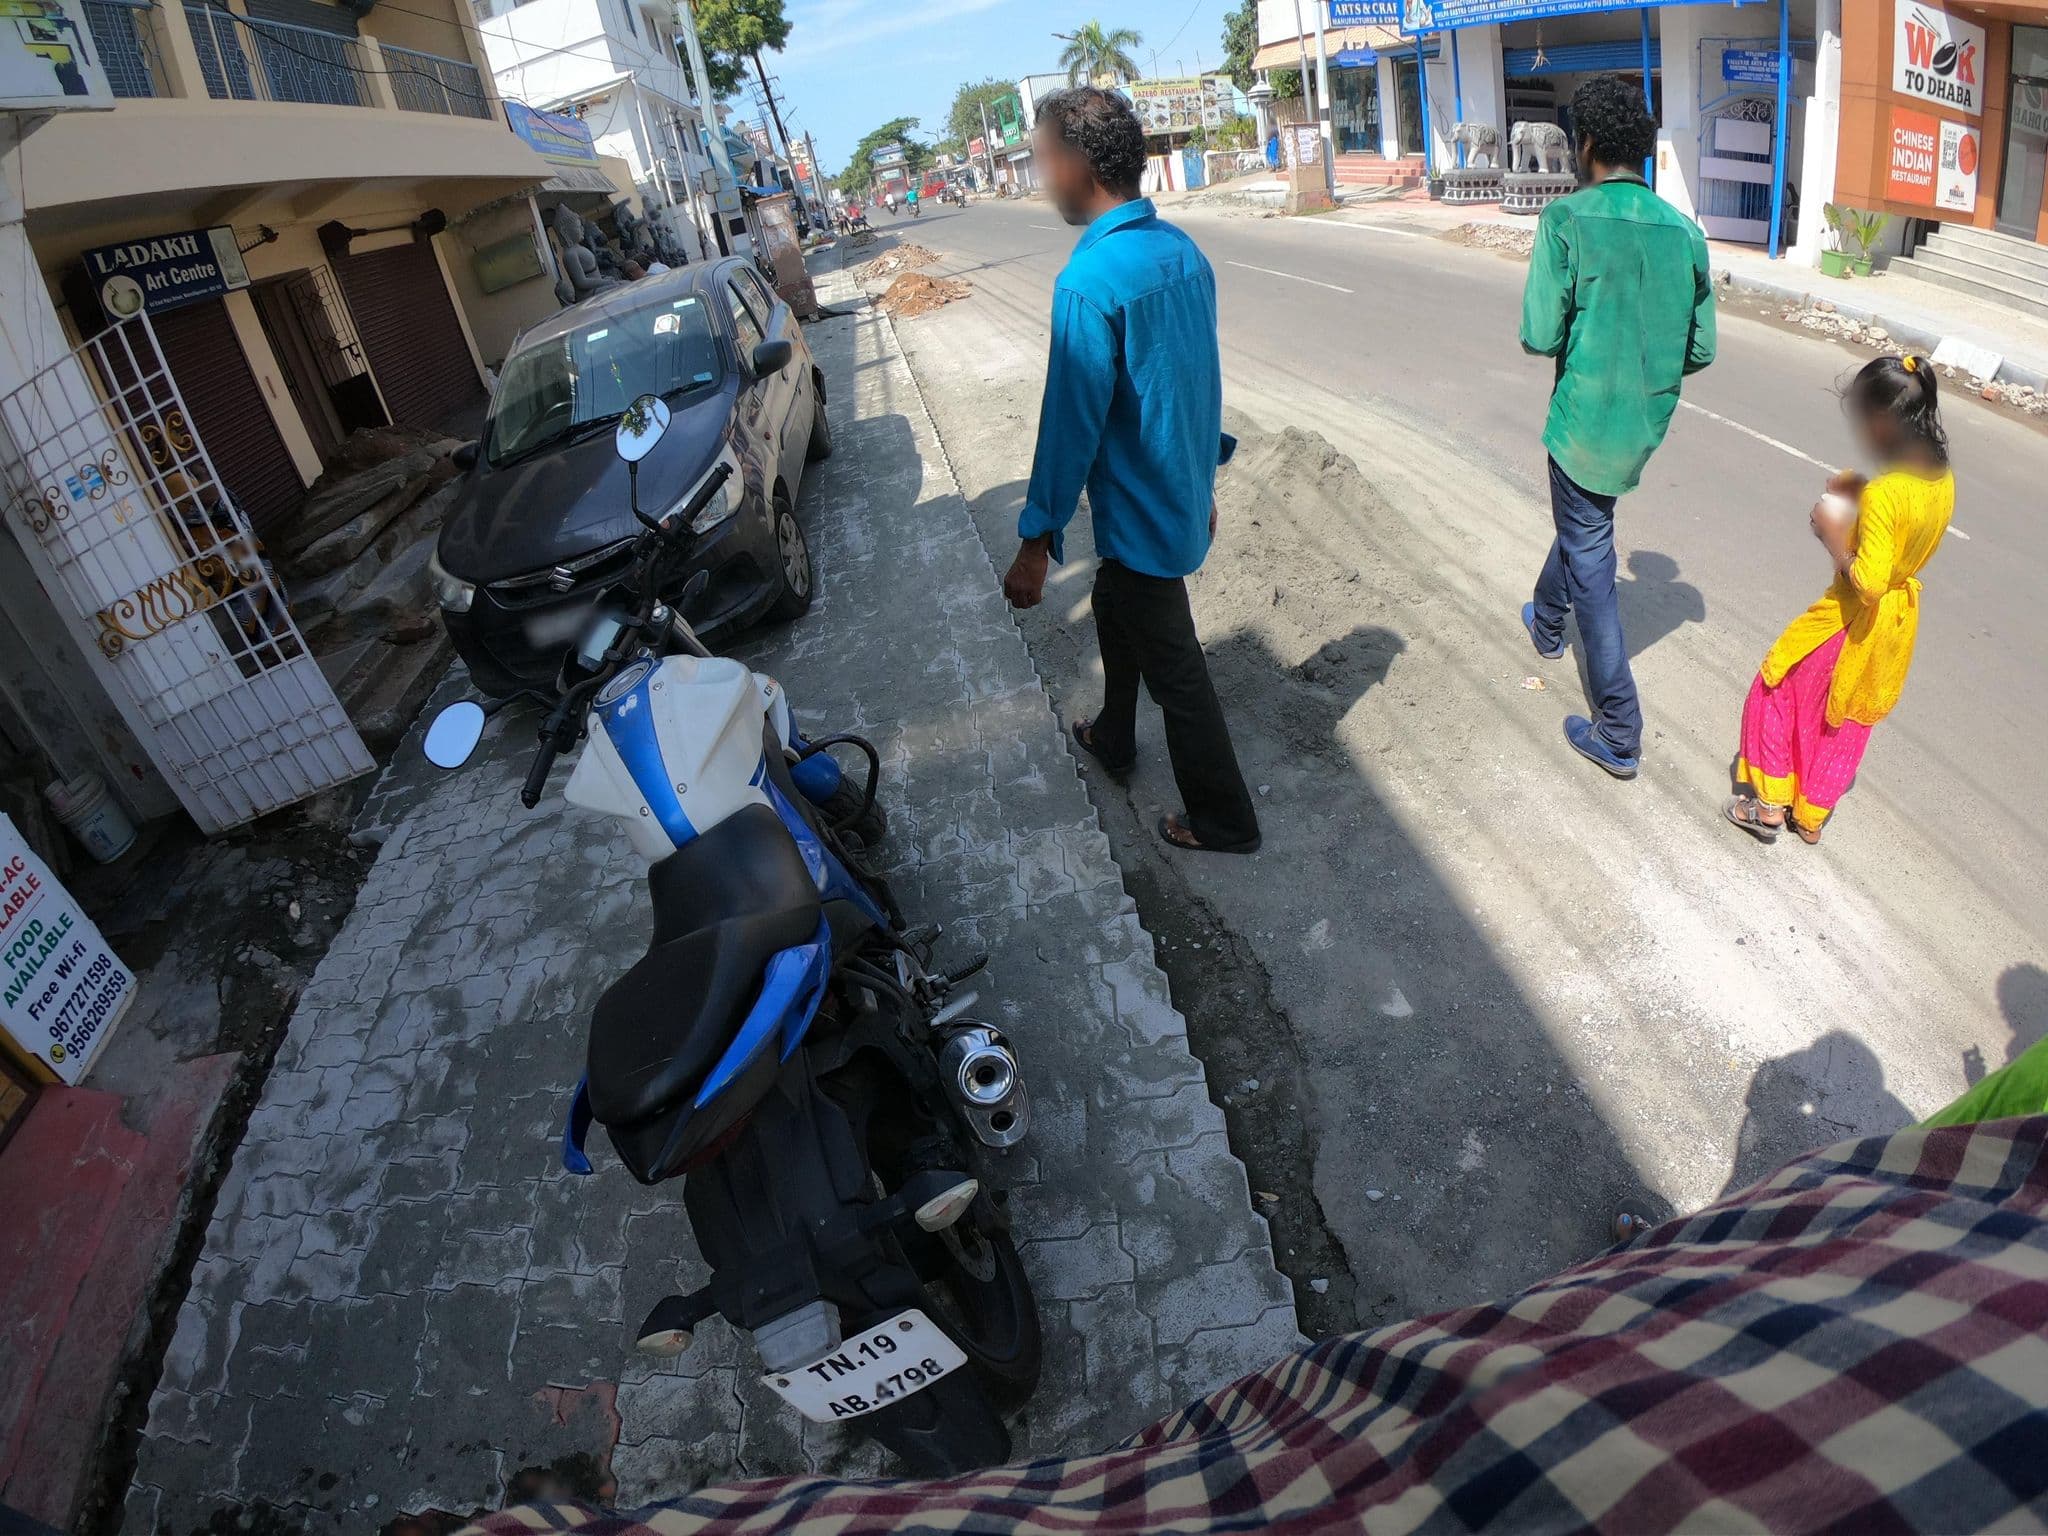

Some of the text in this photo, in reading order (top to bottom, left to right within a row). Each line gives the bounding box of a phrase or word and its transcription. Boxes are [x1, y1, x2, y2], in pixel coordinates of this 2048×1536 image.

[1333, 17, 1376, 25] MANUFACTURER
[1335, 3, 1397, 16] ARTS & CRAF
[1160, 87, 1199, 97] RESTAURANT
[1905, 69, 1972, 107] TO DHABA
[1894, 128, 1934, 151] CHINESE
[1891, 171, 1932, 187] RESTAURANT
[1893, 149, 1933, 174] INDIAN
[95, 234, 200, 273] LADAKH
[145, 262, 216, 292] Art Centre
[0, 872, 41, 935] LABLE
[3, 911, 75, 1010] AVAILABLE
[4, 918, 45, 970] FOOD
[27, 939, 88, 1022] Free Wi-fi
[49, 952, 112, 1043] 9677271598
[64, 968, 127, 1060] 9566269559
[806, 1334, 898, 1382] TN.19
